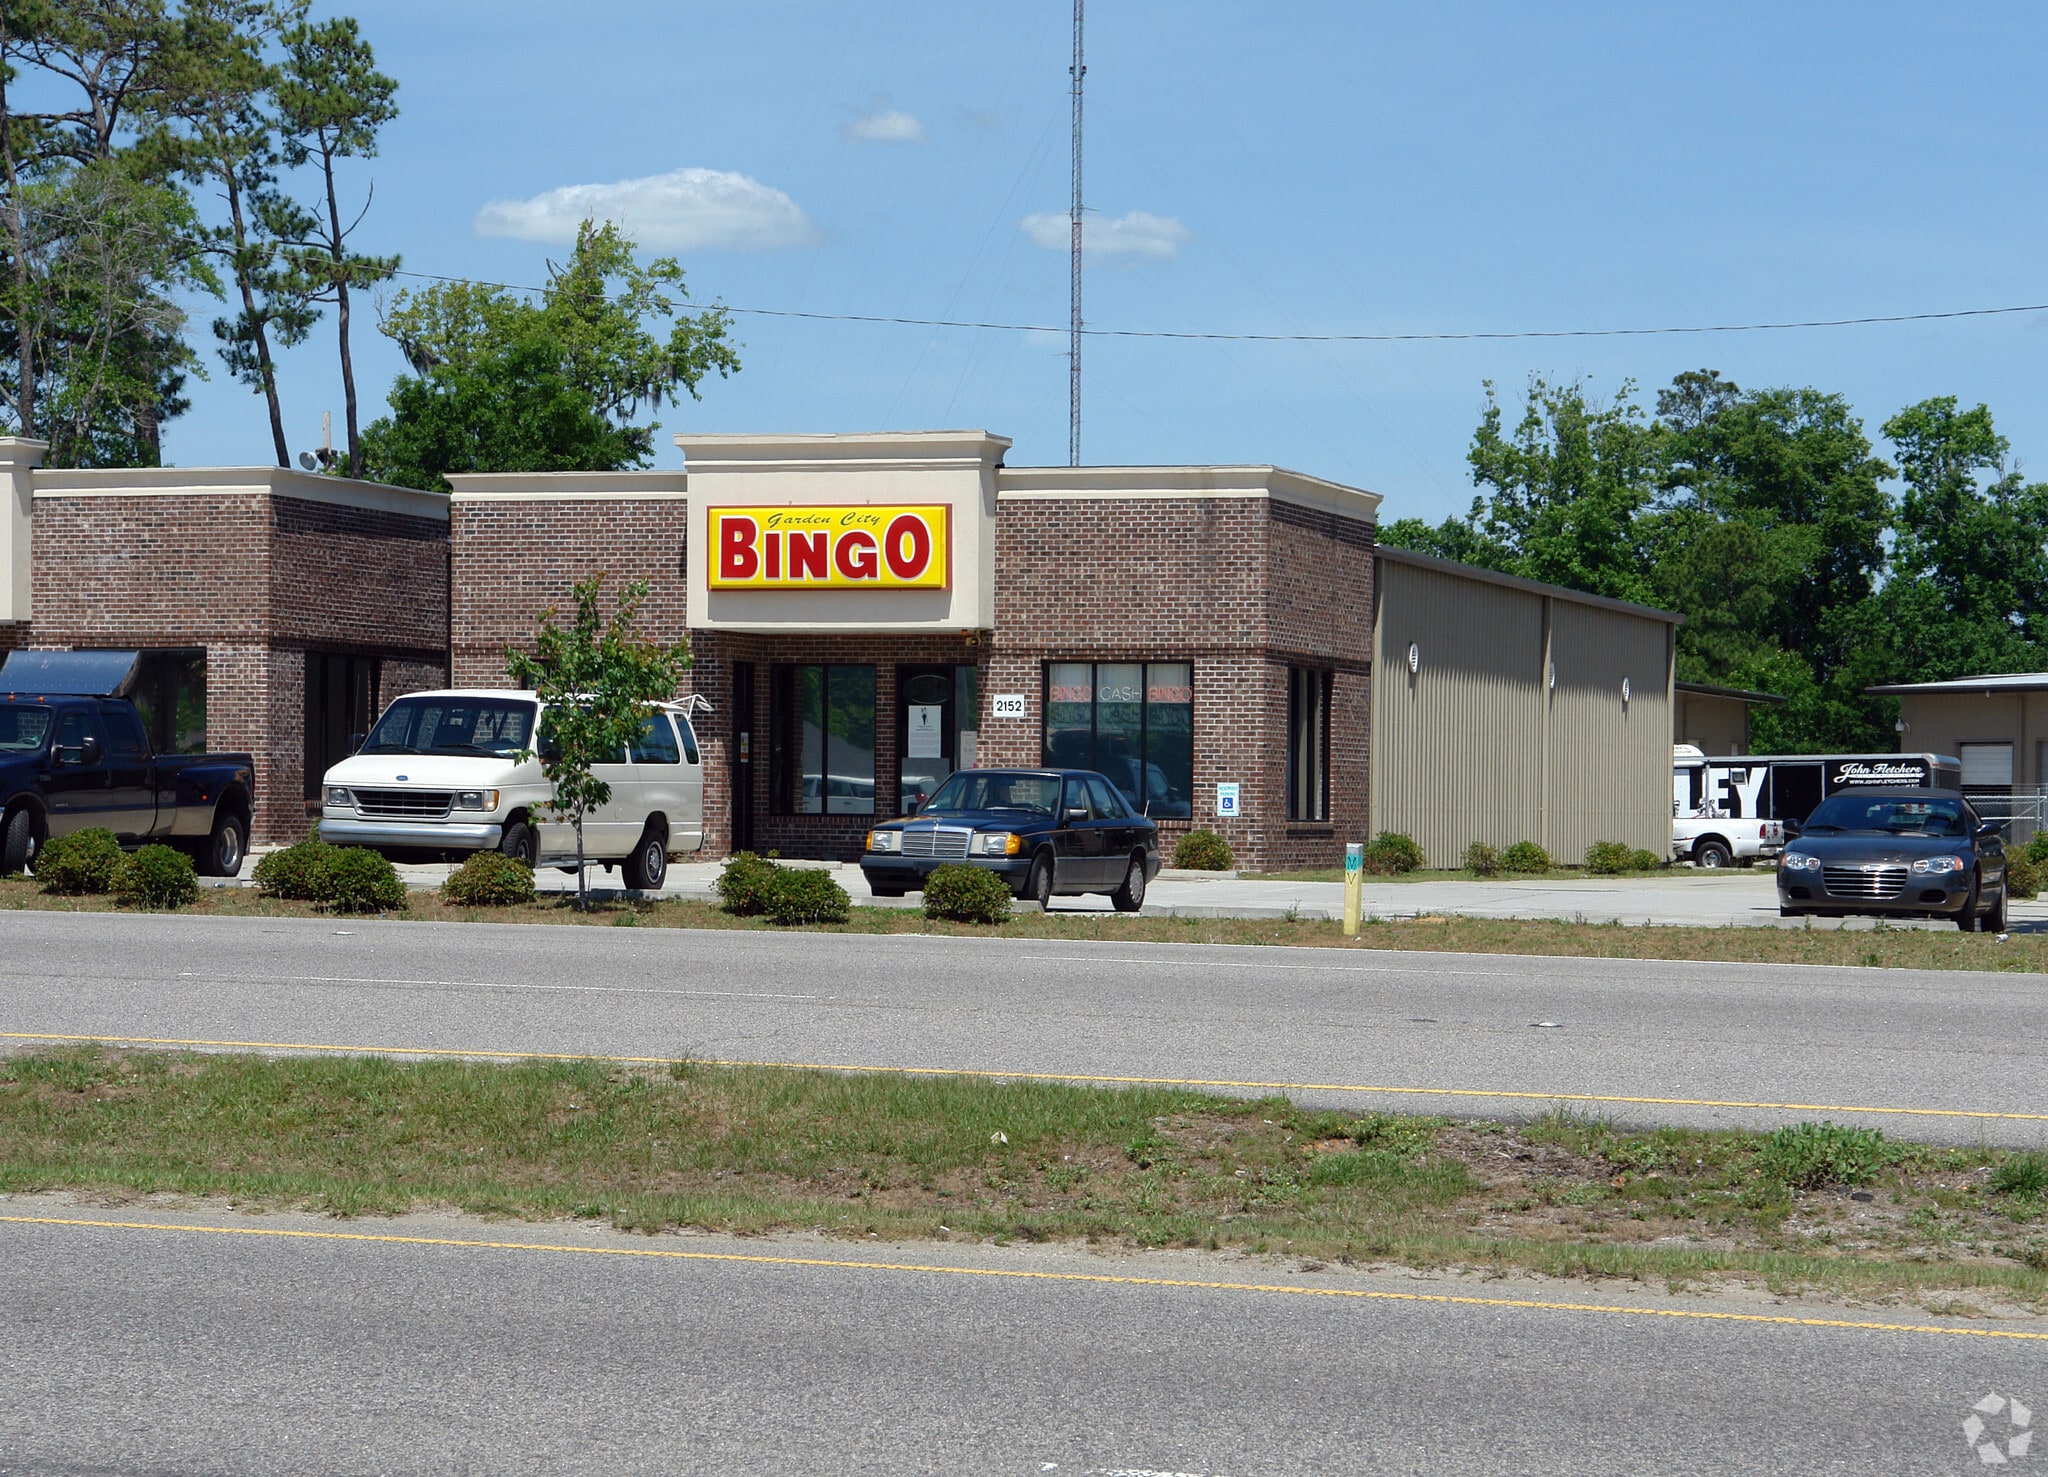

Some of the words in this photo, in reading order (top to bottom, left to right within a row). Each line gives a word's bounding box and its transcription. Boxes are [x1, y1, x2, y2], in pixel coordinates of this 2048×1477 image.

[768, 513, 831, 528] Garden
[840, 512, 881, 526] City
[719, 514, 932, 580] BINGO
[1050, 686, 1092, 701] BINGO
[1100, 686, 1142, 701] CASH
[1149, 687, 1193, 702] BINGO
[996, 700, 1022, 711] 2152
[1833, 763, 1871, 783] John
[1872, 763, 1922, 774] Fletchers
